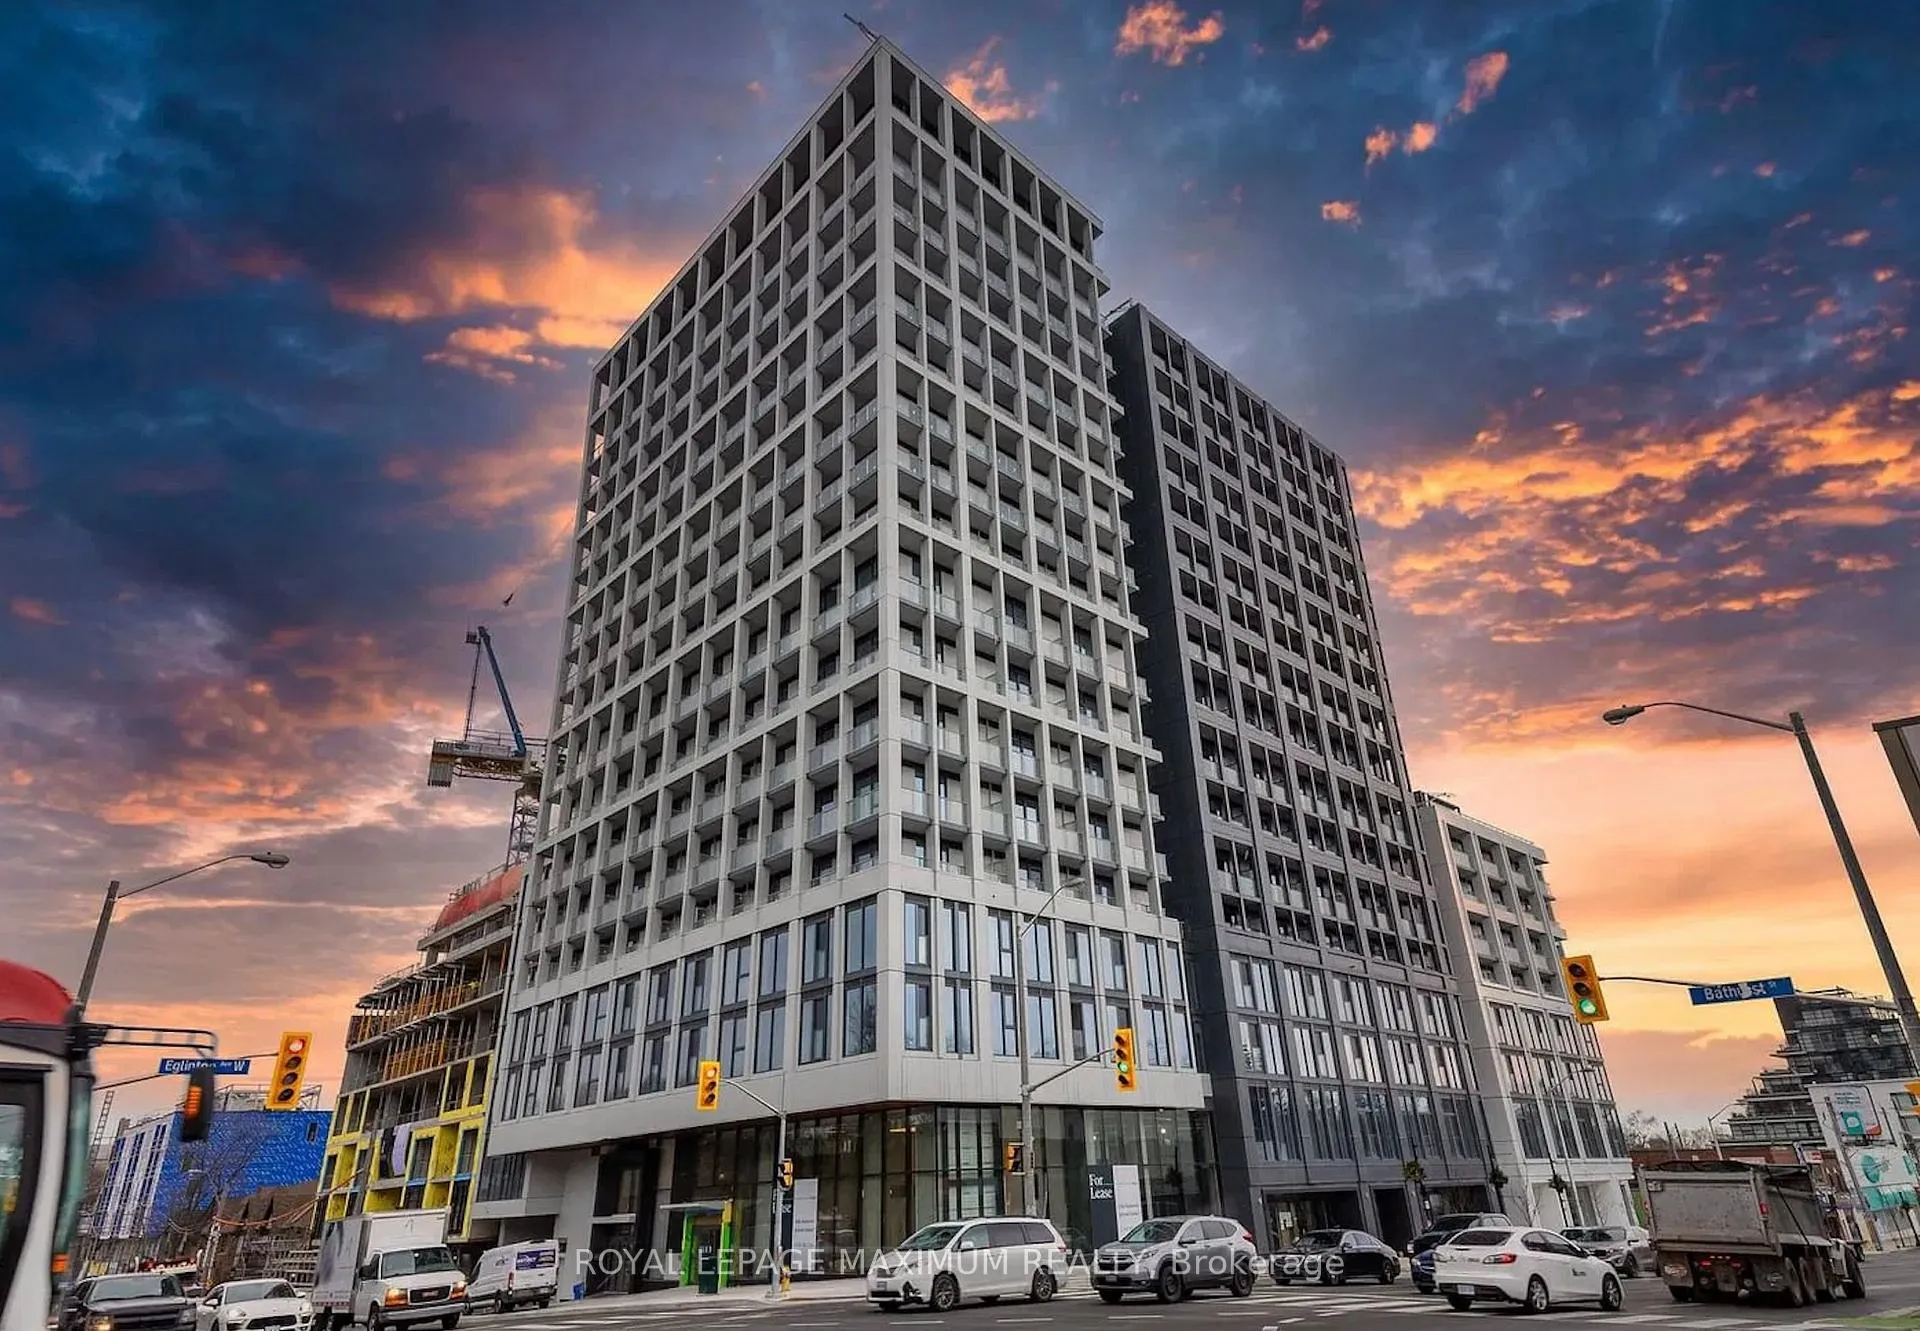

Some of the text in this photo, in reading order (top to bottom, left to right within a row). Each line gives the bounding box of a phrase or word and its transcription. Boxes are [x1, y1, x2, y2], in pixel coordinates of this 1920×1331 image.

[233, 1060, 245, 1072] W
[1089, 1174, 1103, 1186] For
[1090, 1187, 1113, 1199] Lease
